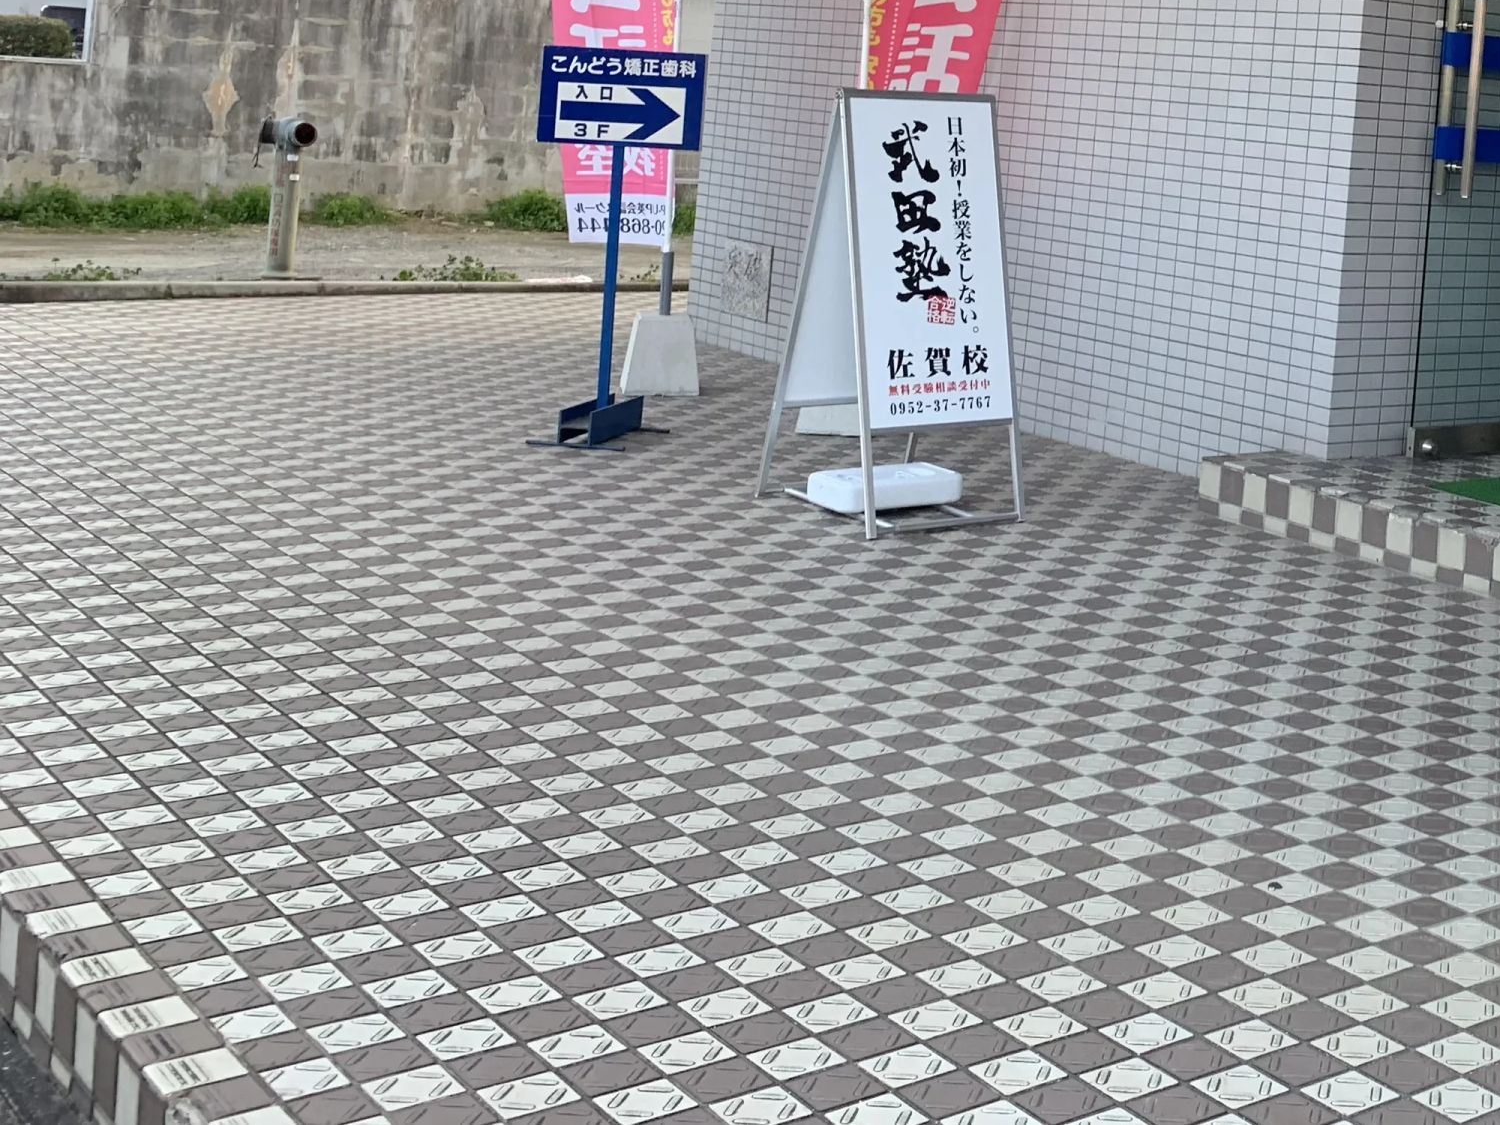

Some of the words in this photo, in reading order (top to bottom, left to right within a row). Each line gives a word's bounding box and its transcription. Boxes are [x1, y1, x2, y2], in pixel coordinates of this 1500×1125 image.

[551, 55, 697, 79] こんどう矯正歯科
[575, 85, 613, 101] 入口
[882, 120, 951, 303] 武田塾
[887, 344, 989, 380] 佐賀校
[889, 378, 991, 397] 無料受験相談受付中
[890, 395, 991, 416] 0952-37-7767
